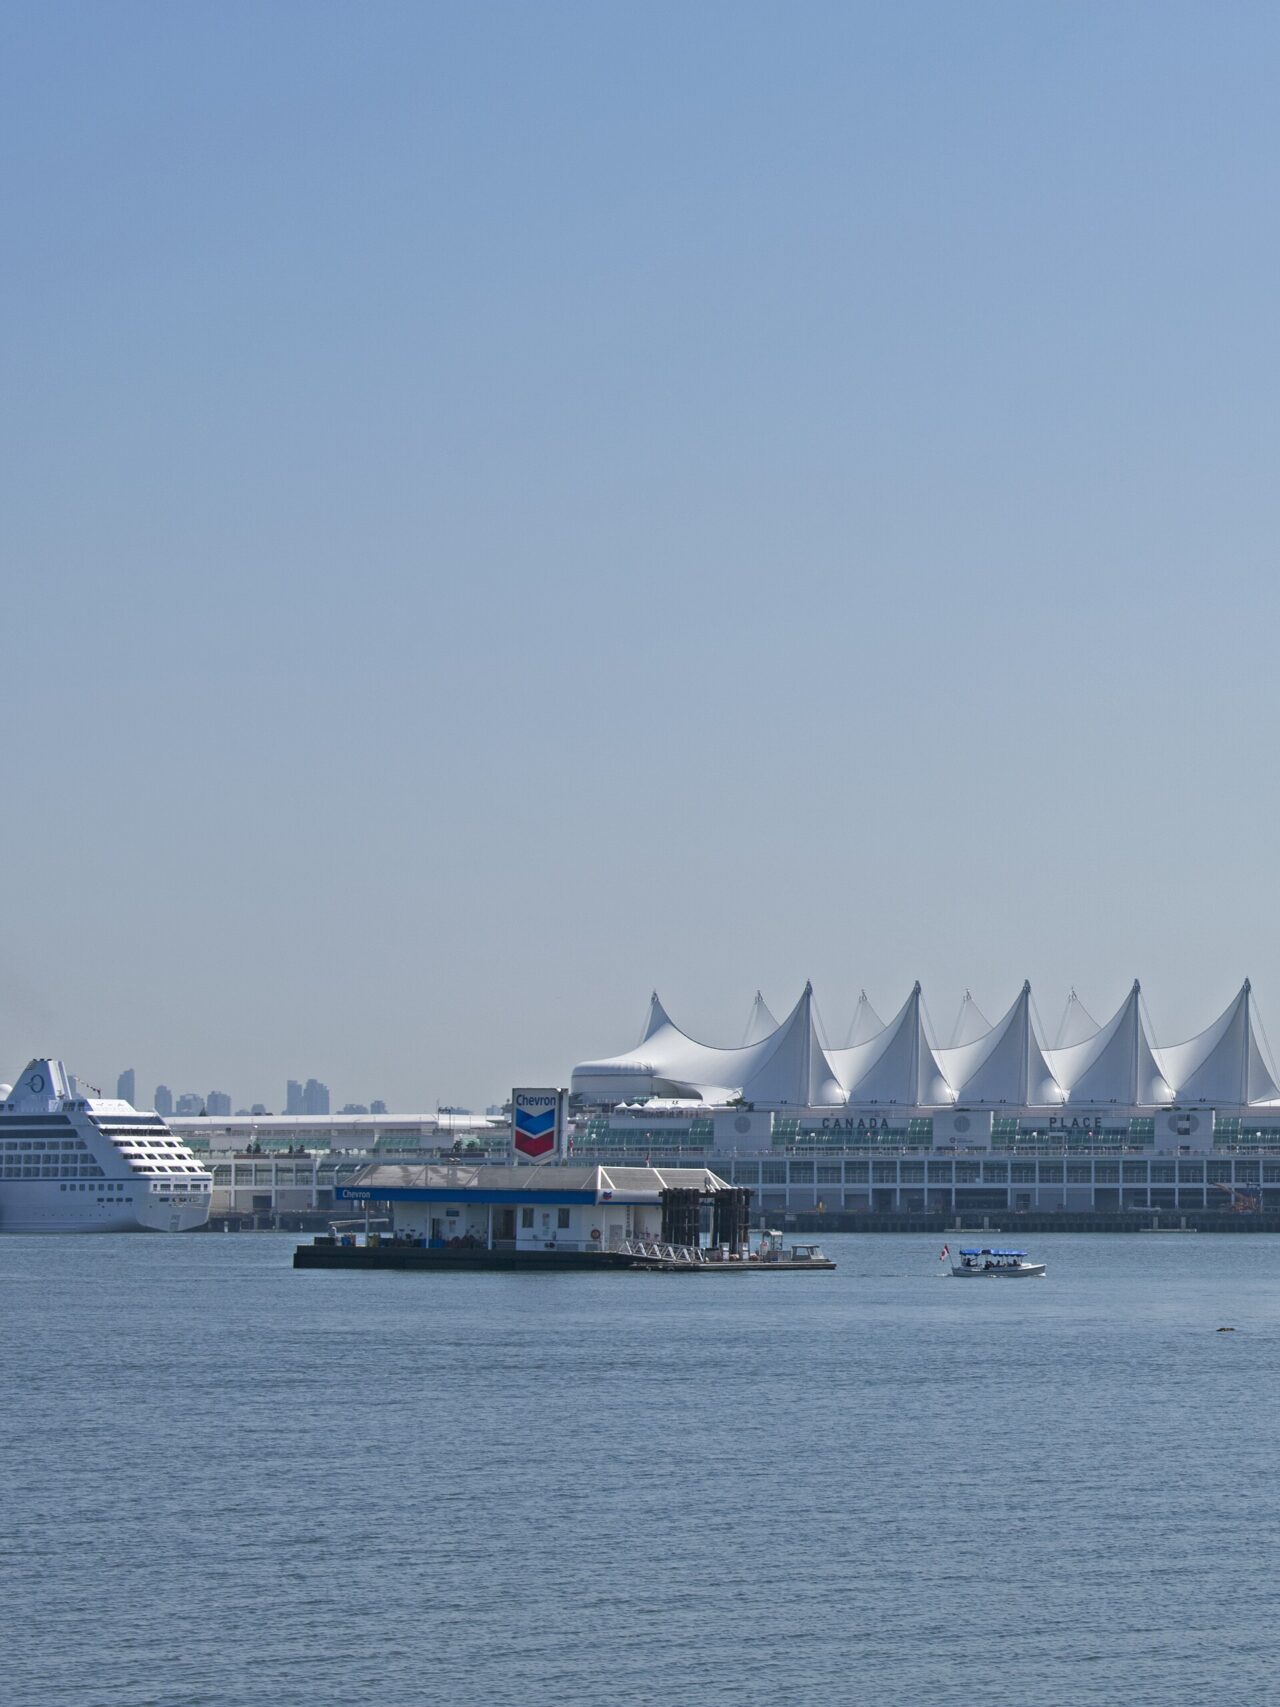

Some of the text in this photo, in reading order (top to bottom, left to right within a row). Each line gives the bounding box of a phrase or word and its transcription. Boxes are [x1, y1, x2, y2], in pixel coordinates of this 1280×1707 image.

[516, 1094, 556, 1106] Chevron
[822, 1117, 1102, 1129] CANADA PLACE
[342, 1189, 371, 1199] Chevron
